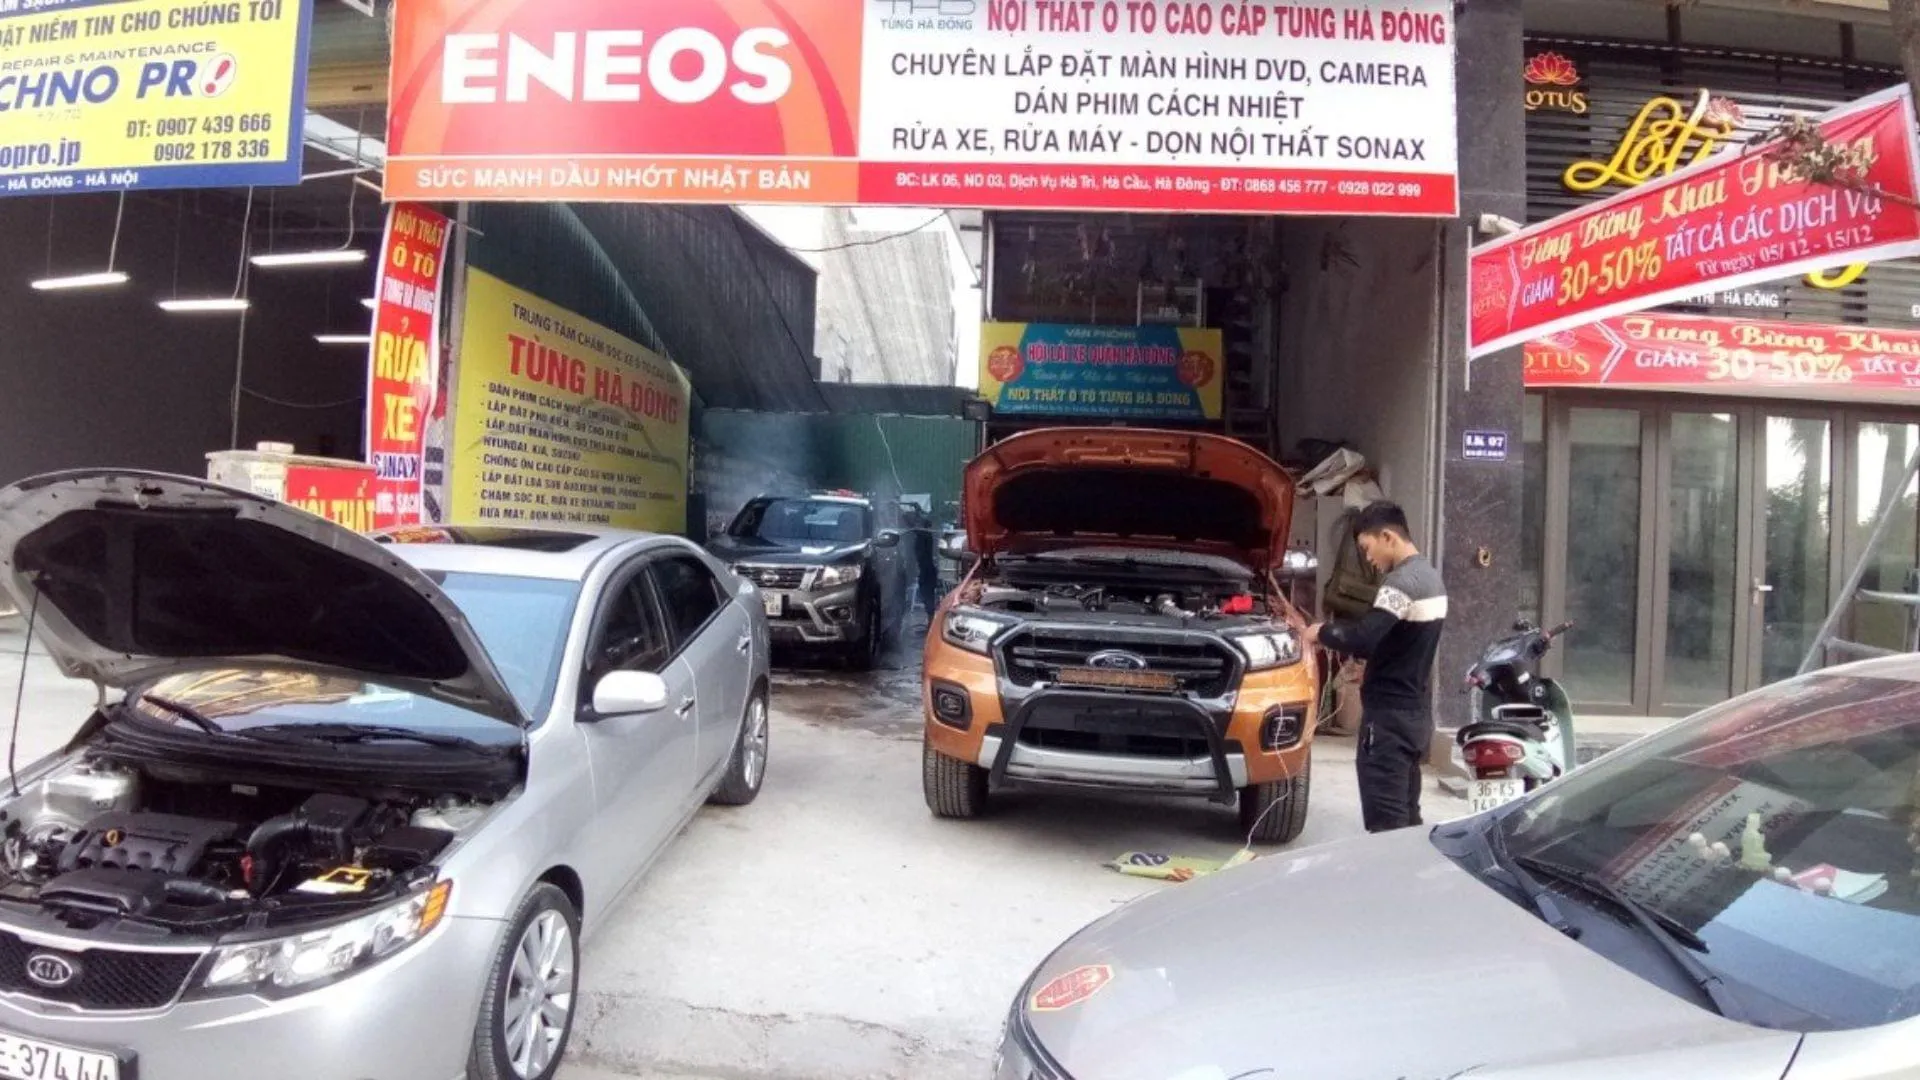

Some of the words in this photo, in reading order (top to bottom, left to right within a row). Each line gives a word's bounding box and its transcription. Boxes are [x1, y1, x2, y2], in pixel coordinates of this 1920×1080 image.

[84, 15, 115, 37] TIN
[120, 10, 161, 33] CHO
[1165, 1, 1212, 35] CAO
[1344, 4, 1374, 41] HÀ
[1381, 6, 1445, 45] ĐÔNG
[2, 55, 60, 71] REPAIR
[64, 54, 75, 65] &
[80, 41, 217, 62] MAINTENANCE
[441, 26, 792, 105] ENEOS
[891, 47, 996, 76] CHUYÊN
[1003, 44, 1052, 77] LẮP
[1060, 52, 1112, 83] ĐẶT
[1120, 50, 1177, 78] MÀN
[1186, 51, 1247, 80] HÌNH
[1256, 58, 1312, 87] DVD,
[1320, 60, 1428, 88] CAMERA
[1015, 86, 1067, 114] DÁN
[1076, 92, 1138, 115] PHIM
[1147, 87, 1219, 117] CÁCH
[1228, 91, 1304, 125] NHIỆT
[156, 118, 196, 136] 0907
[201, 115, 234, 134] 439
[239, 113, 271, 132] 666
[892, 120, 947, 151] RỬA
[956, 128, 995, 155] XE,
[1003, 122, 1059, 152] RỬA
[1069, 123, 1122, 152] MÁY
[1147, 131, 1201, 160] DỌN
[1211, 127, 1254, 161] NỘI
[1261, 125, 1328, 159] THẤT
[1337, 136, 1425, 161] SONAX
[154, 143, 196, 162] 0902
[200, 140, 233, 160] 178
[237, 139, 270, 158] 336
[8, 176, 27, 191] HÀ
[85, 170, 107, 187] HÀ
[110, 170, 139, 188] NỘI
[417, 164, 467, 188] SỨC
[474, 167, 542, 192] MẠNH
[550, 160, 599, 189] DẦU
[607, 163, 676, 188] NHỚT
[684, 165, 752, 194] NHẬT
[758, 163, 812, 190] BẢN
[921, 173, 939, 187] LK
[1155, 176, 1172, 190] Hà
[1305, 180, 1328, 193] 777
[1650, 170, 1728, 224] Khai
[392, 241, 408, 268] Ô
[413, 251, 435, 278] TÔ
[1557, 238, 1662, 306] 30-50%
[1665, 219, 1697, 262] TẤT
[1699, 211, 1725, 253] CẢ
[1730, 204, 1774, 245] CÁC
[1780, 189, 1837, 236] DỊCH
[1721, 253, 1756, 275] ngày
[1826, 225, 1875, 249] 15/12
[512, 302, 551, 332] TRUNG
[376, 316, 431, 386] RỬA
[1835, 332, 1920, 355] Khai
[508, 332, 585, 395] TÙNG
[595, 361, 624, 407] HÀ
[631, 380, 678, 425] ĐÔNG
[1706, 345, 1852, 381] 30-50%
[1862, 353, 1897, 375] TẤT
[383, 393, 418, 441] XE
[35, 961, 64, 980] KIA
